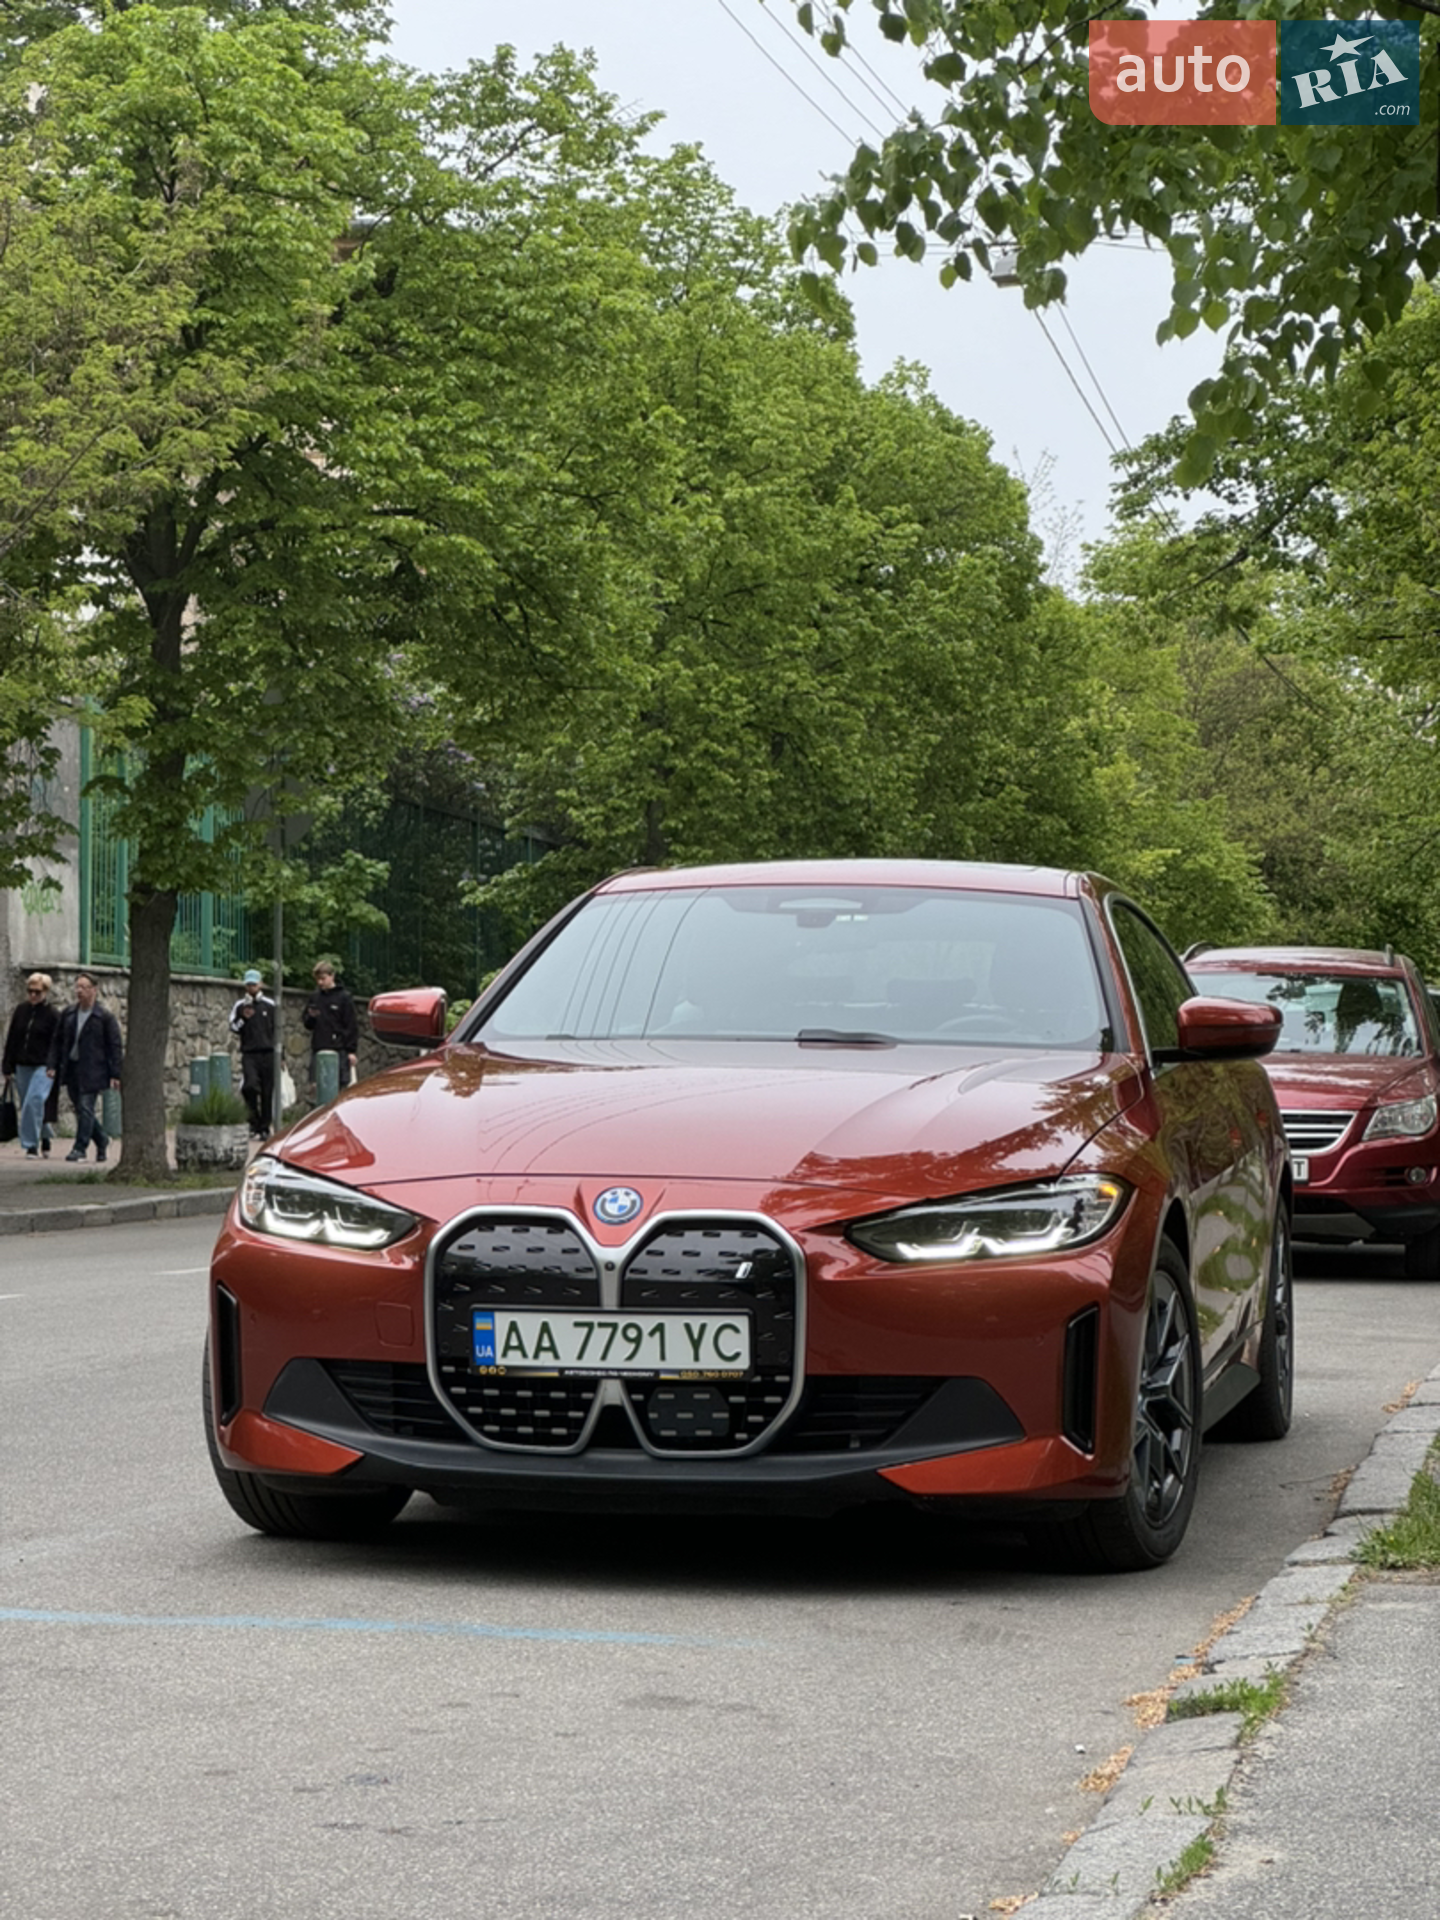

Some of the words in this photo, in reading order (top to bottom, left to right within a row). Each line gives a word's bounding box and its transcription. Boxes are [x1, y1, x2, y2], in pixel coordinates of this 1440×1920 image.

[476, 1345, 494, 1358] UA
[501, 1320, 560, 1361] AA
[573, 1321, 666, 1362] 7791
[683, 1322, 742, 1363] YC
